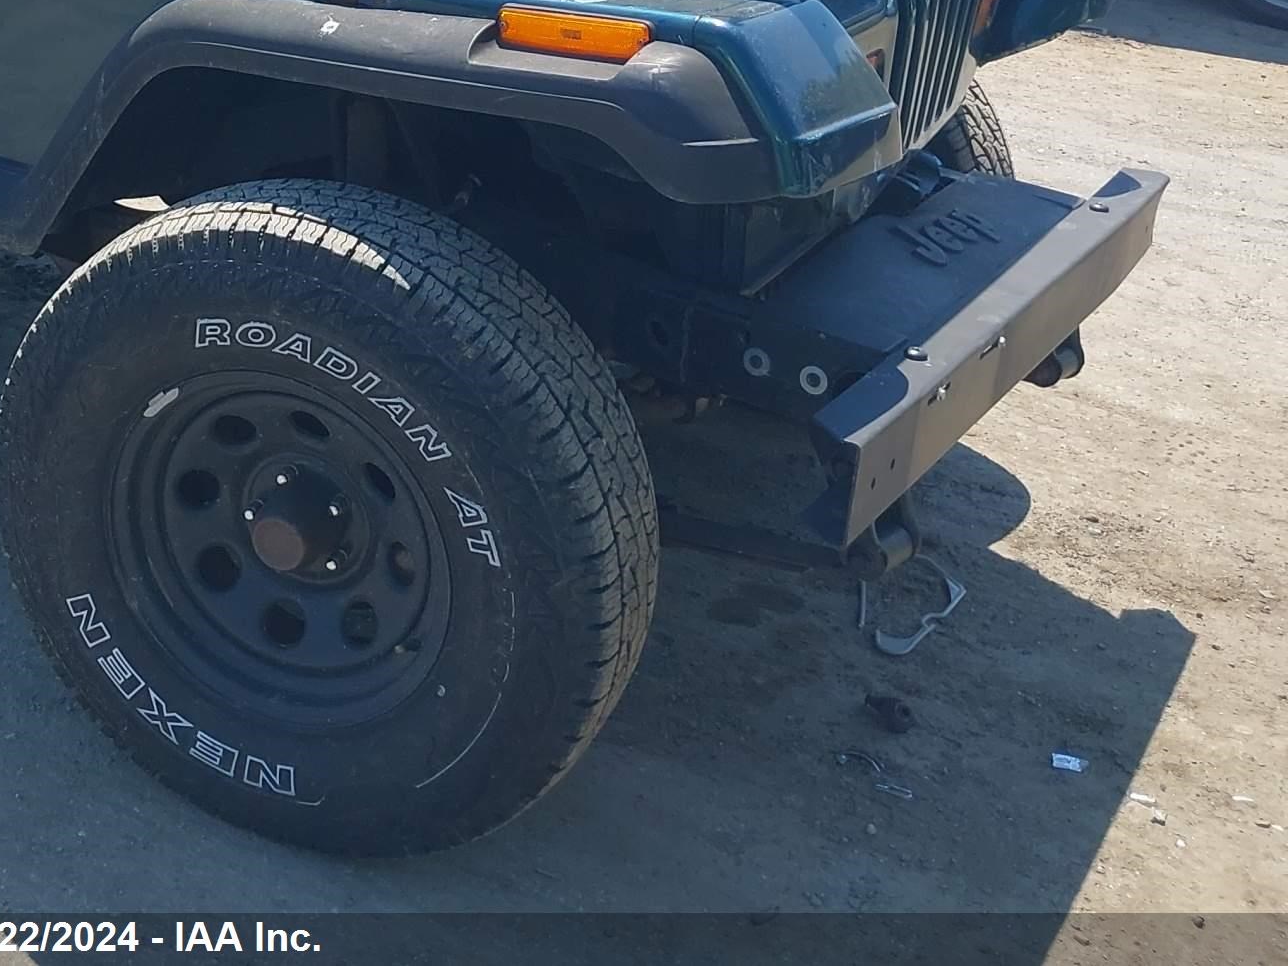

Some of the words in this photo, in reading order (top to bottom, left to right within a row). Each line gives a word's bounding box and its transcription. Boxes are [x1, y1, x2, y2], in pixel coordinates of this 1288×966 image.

[894, 208, 1000, 266] Jeep
[194, 317, 451, 463] ROADIAN
[443, 487, 500, 568] AT
[66, 594, 296, 797] NEXEN
